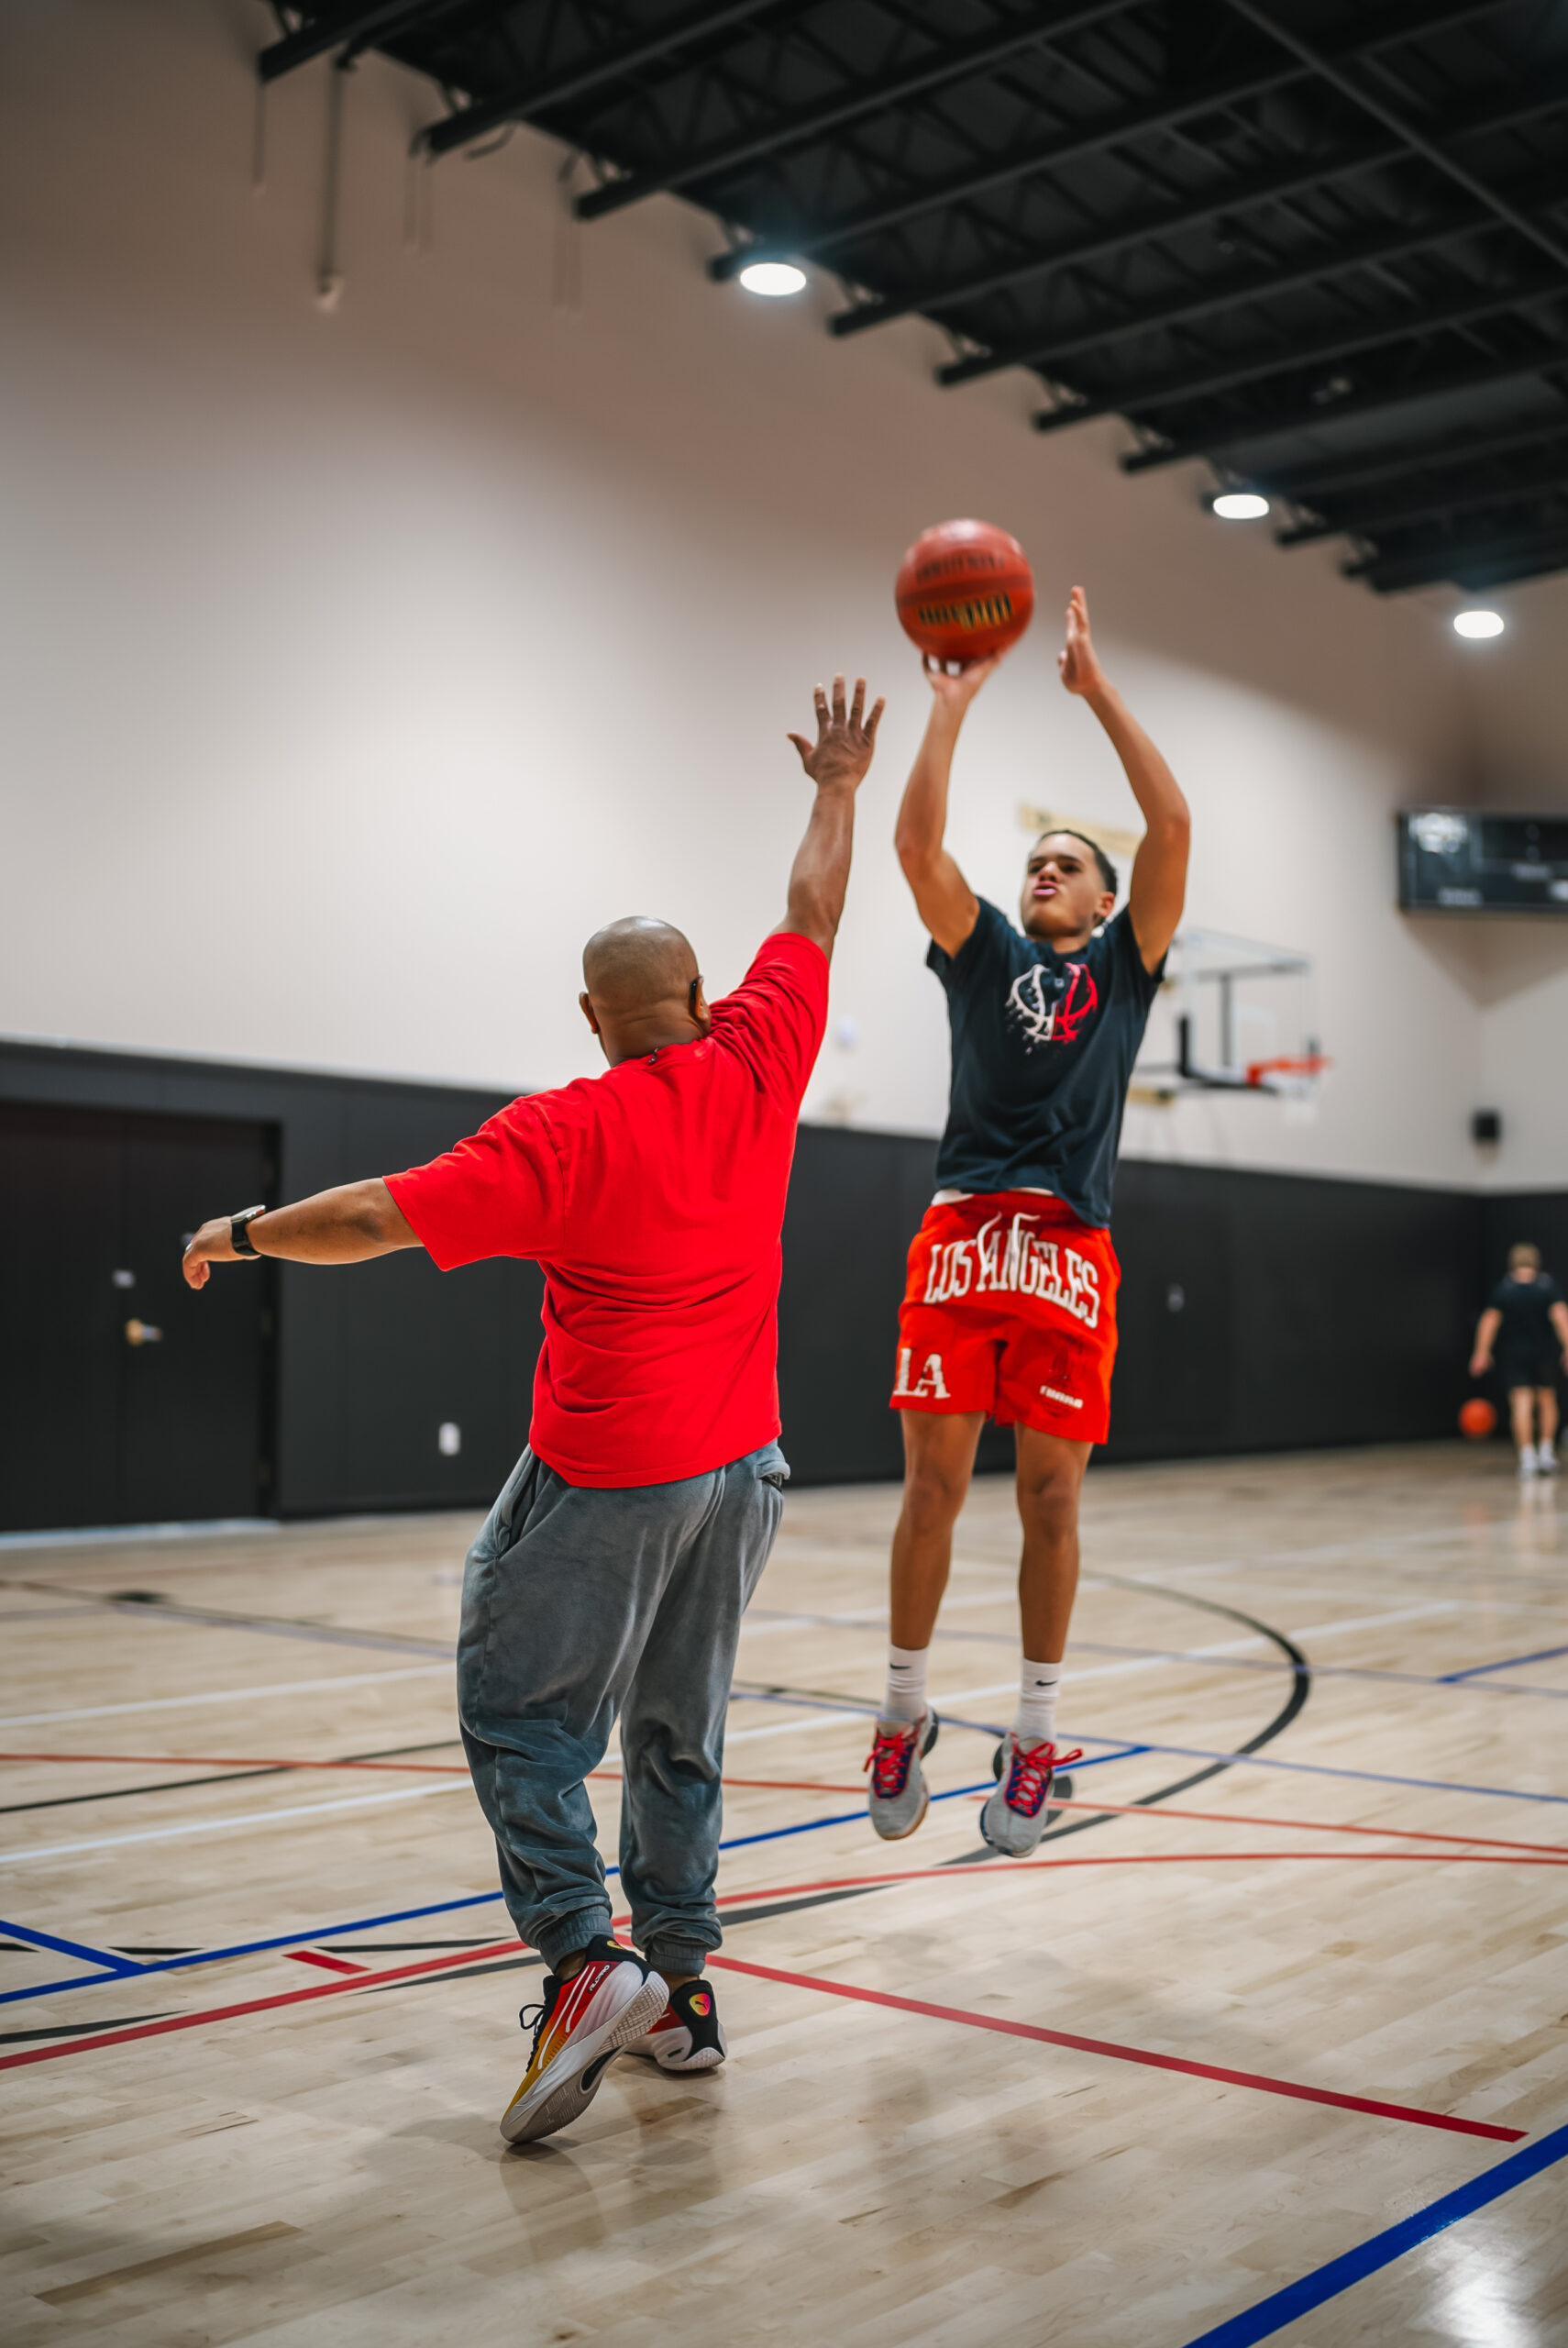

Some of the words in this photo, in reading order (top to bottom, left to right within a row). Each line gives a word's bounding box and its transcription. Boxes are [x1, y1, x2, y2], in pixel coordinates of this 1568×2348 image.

[923, 1239, 977, 1304] LOS
[975, 1229, 1100, 1329] ANGELES
[893, 1347, 951, 1399] LA
